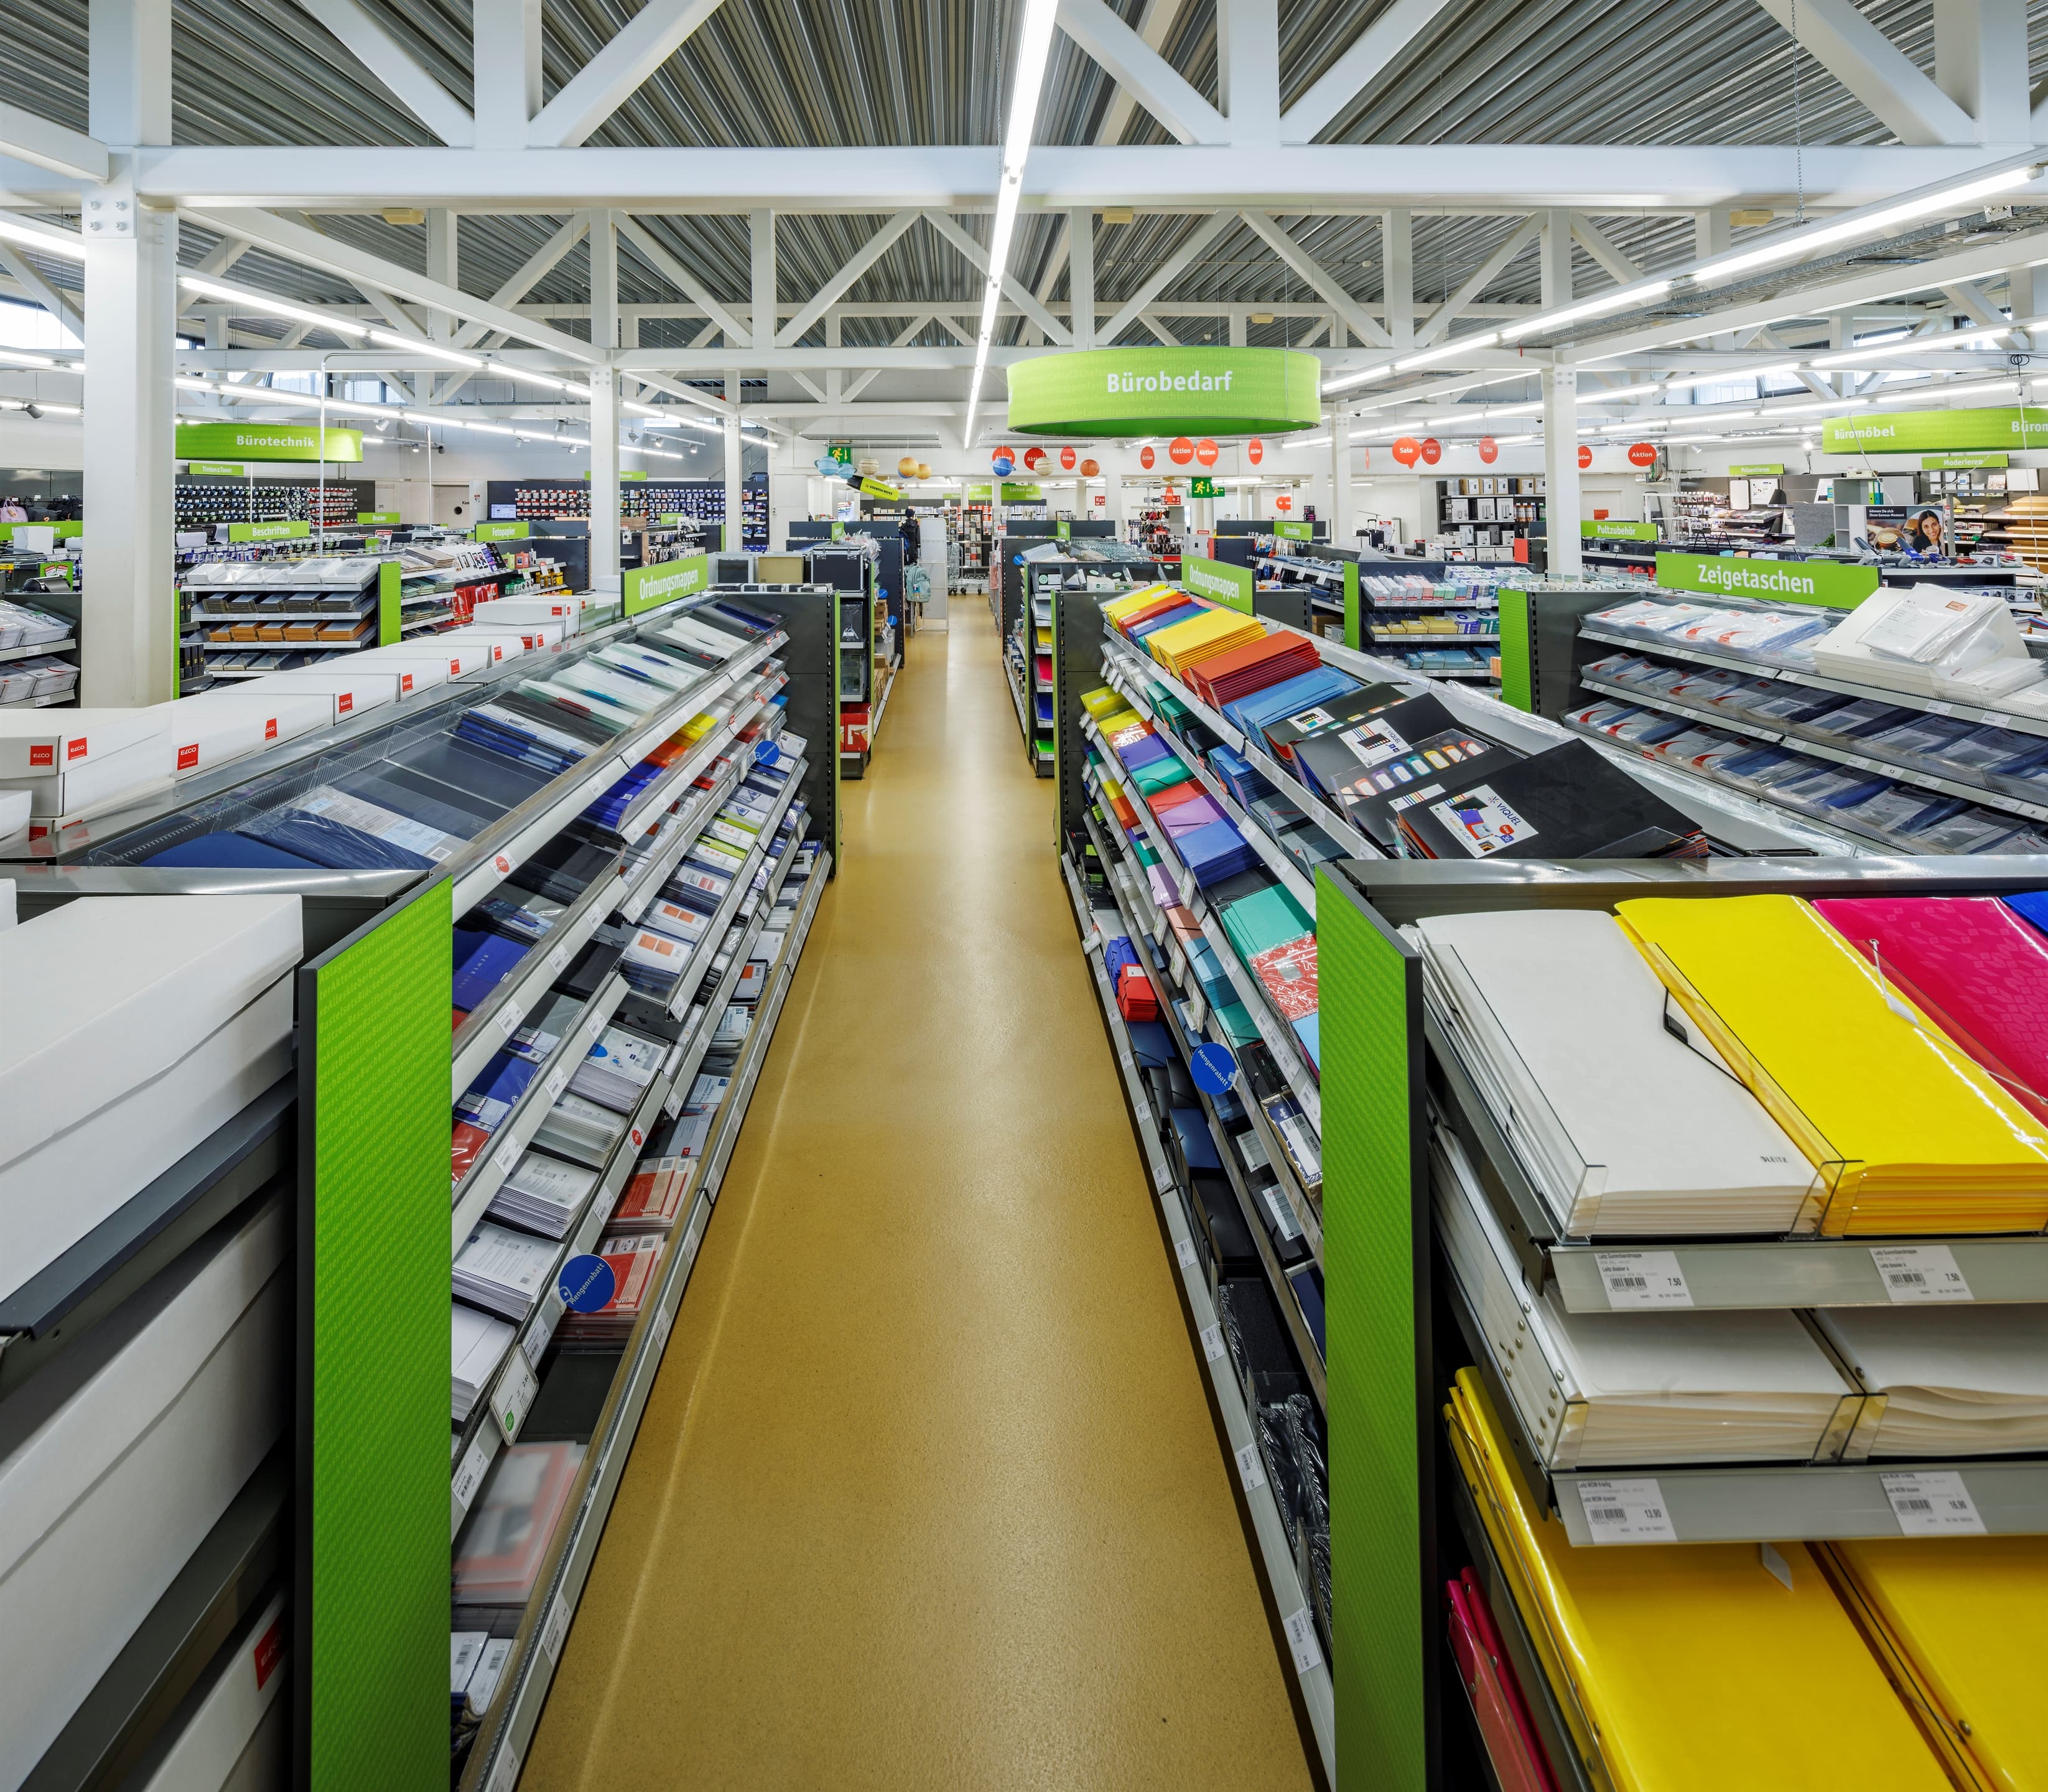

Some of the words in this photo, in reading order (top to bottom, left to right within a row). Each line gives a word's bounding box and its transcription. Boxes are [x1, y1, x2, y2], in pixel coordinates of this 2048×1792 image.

[1107, 370, 1233, 393] Bürobedarf
[1834, 425, 1896, 440] Büromöbel
[236, 435, 314, 448] Bürotechnik
[252, 526, 290, 537] Beschriften
[492, 527, 516, 537] Fotopapier
[1283, 525, 1301, 536] Schneiden
[1597, 525, 1636, 536] Pultzubehör
[639, 568, 699, 600] Ordnungsmappen
[1189, 566, 1240, 600] Ordnungsmappen
[1697, 564, 1815, 594] Zeigetaschen
[180, 747, 197, 755] ELCO
[1496, 801, 1520, 826] VIQUEL
[1197, 1048, 1229, 1087] Mengenrabatt
[569, 1262, 605, 1305] Mengenrabatt
[1667, 1277, 1682, 1286] 7.50
[1945, 1273, 1960, 1282] 7.50
[1644, 1509, 1662, 1518] 13.90
